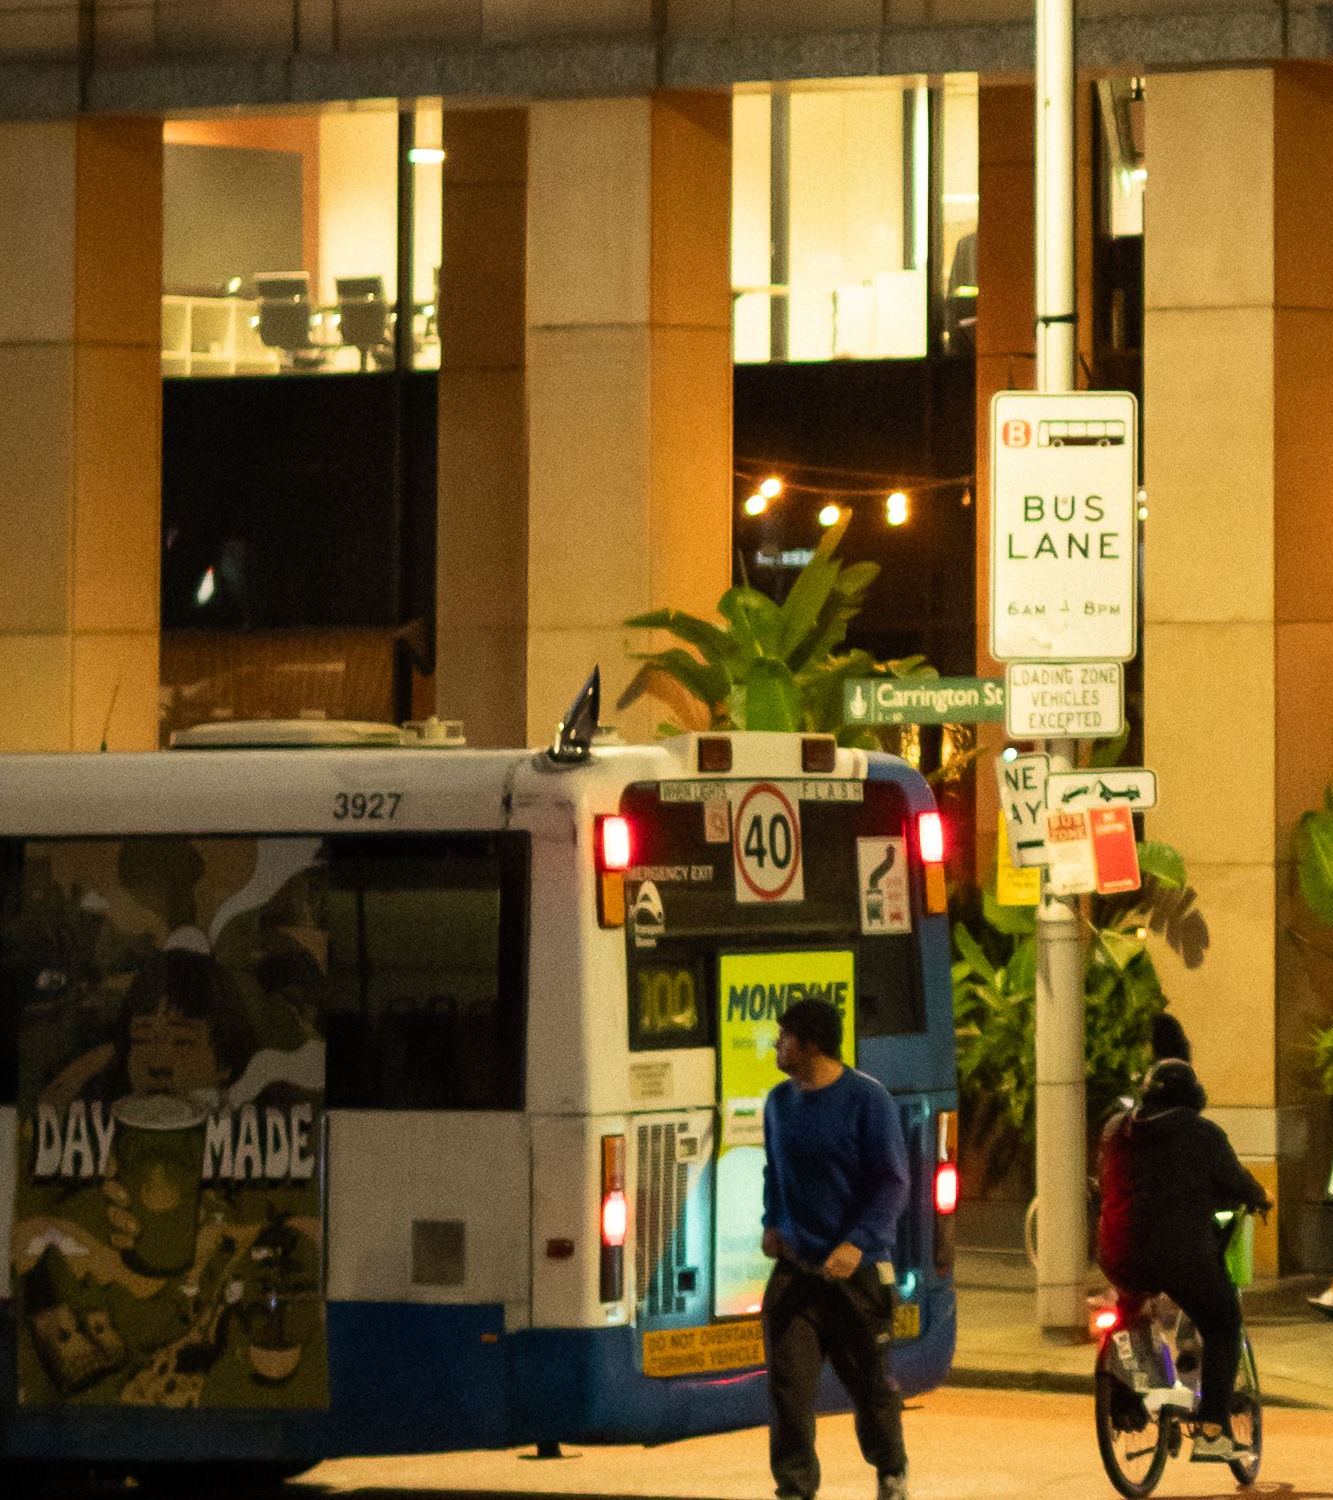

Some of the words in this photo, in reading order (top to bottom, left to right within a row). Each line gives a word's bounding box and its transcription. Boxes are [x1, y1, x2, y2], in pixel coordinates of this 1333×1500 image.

[1024, 495, 1105, 523] BUS
[1008, 532, 1120, 560] LANE
[1008, 602, 1047, 616] 6AM
[1084, 601, 1121, 616] 8PM
[1012, 667, 1074, 686] LOADING
[1081, 667, 1118, 684] ZONE
[876, 682, 980, 714] Carrington
[984, 682, 1004, 706] St
[1031, 689, 1100, 707] VEHICLES
[1029, 711, 1101, 729] EXCEPTED
[1004, 766, 1038, 791] NE
[801, 782, 862, 800] FLASH
[333, 792, 403, 819] 3927
[1011, 801, 1043, 825] AY
[745, 814, 792, 869] 40
[35, 1101, 115, 1177] DAY
[202, 1103, 314, 1179] MADE
[671, 1332, 695, 1349] NOT
